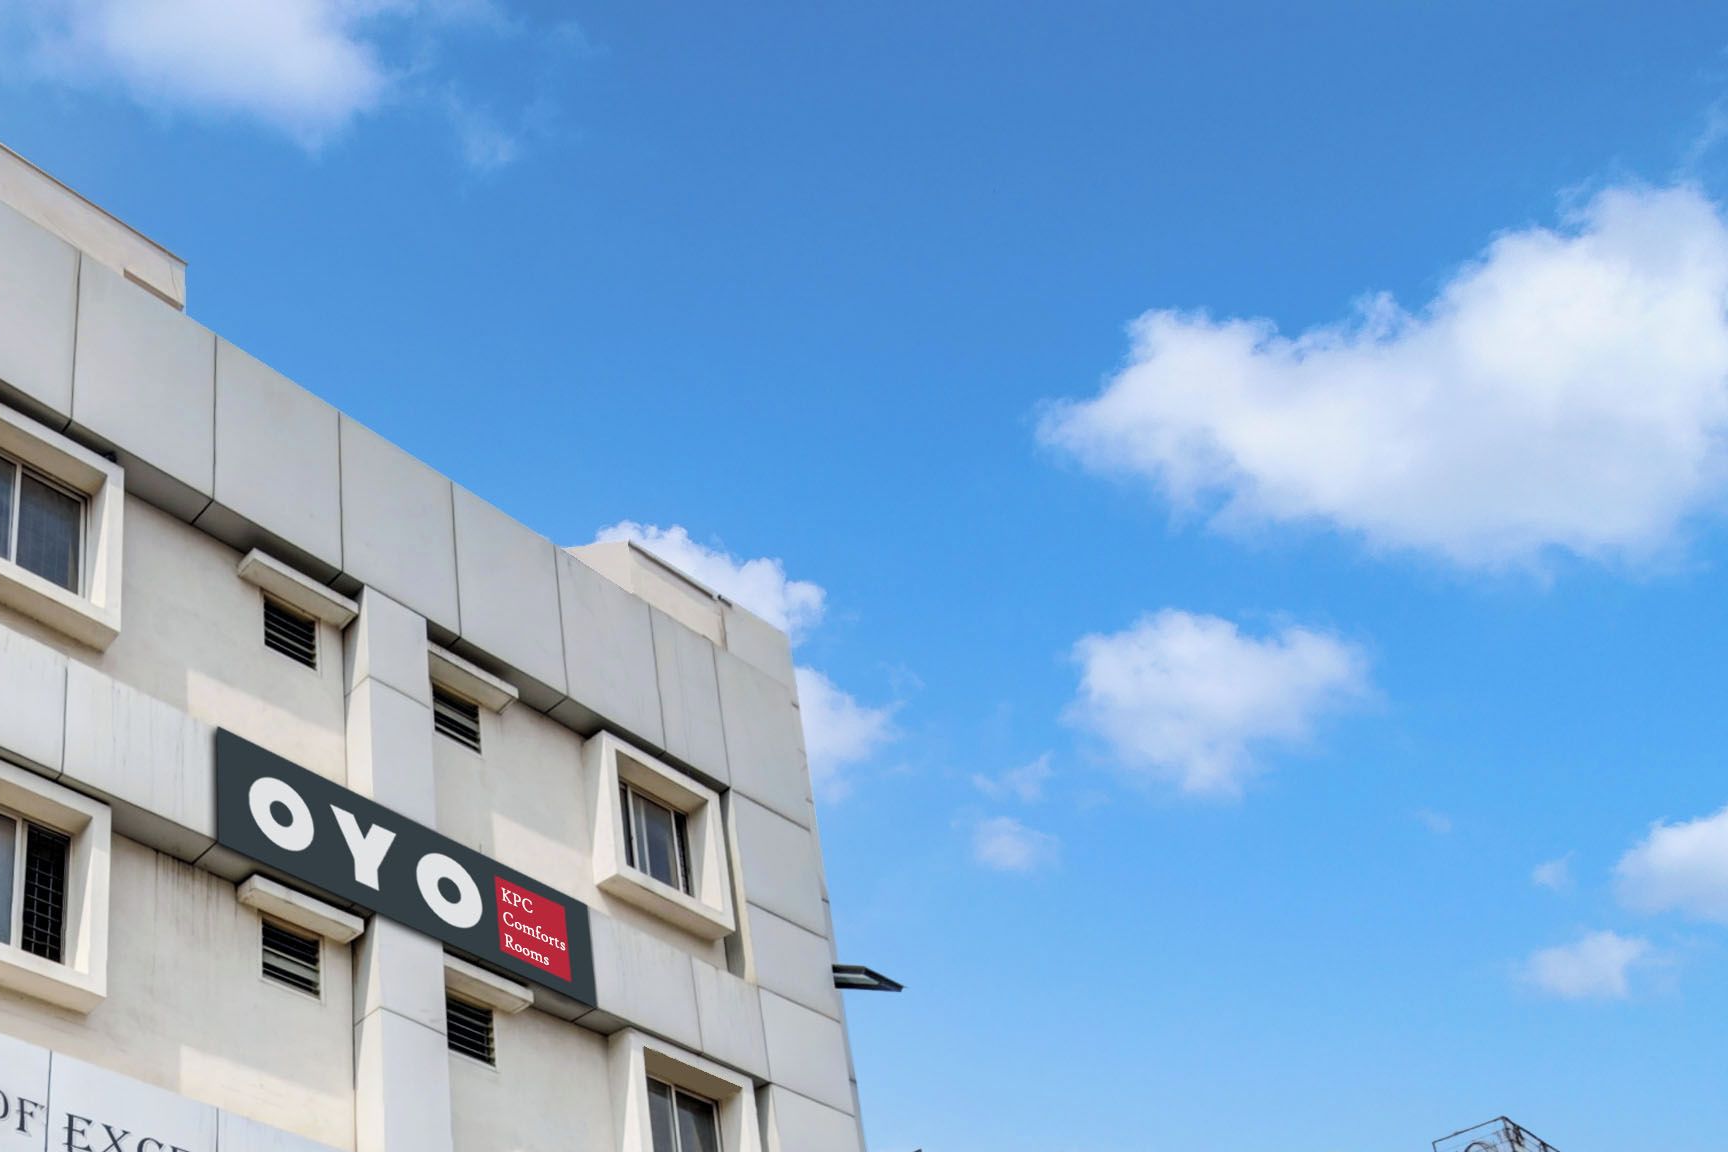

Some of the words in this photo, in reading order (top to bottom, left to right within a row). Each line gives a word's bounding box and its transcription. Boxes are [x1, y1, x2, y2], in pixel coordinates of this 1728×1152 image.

[248, 776, 483, 929] OYO
[501, 887, 534, 914] KPC
[503, 912, 566, 951] Comforts
[505, 934, 550, 967] Rooms
